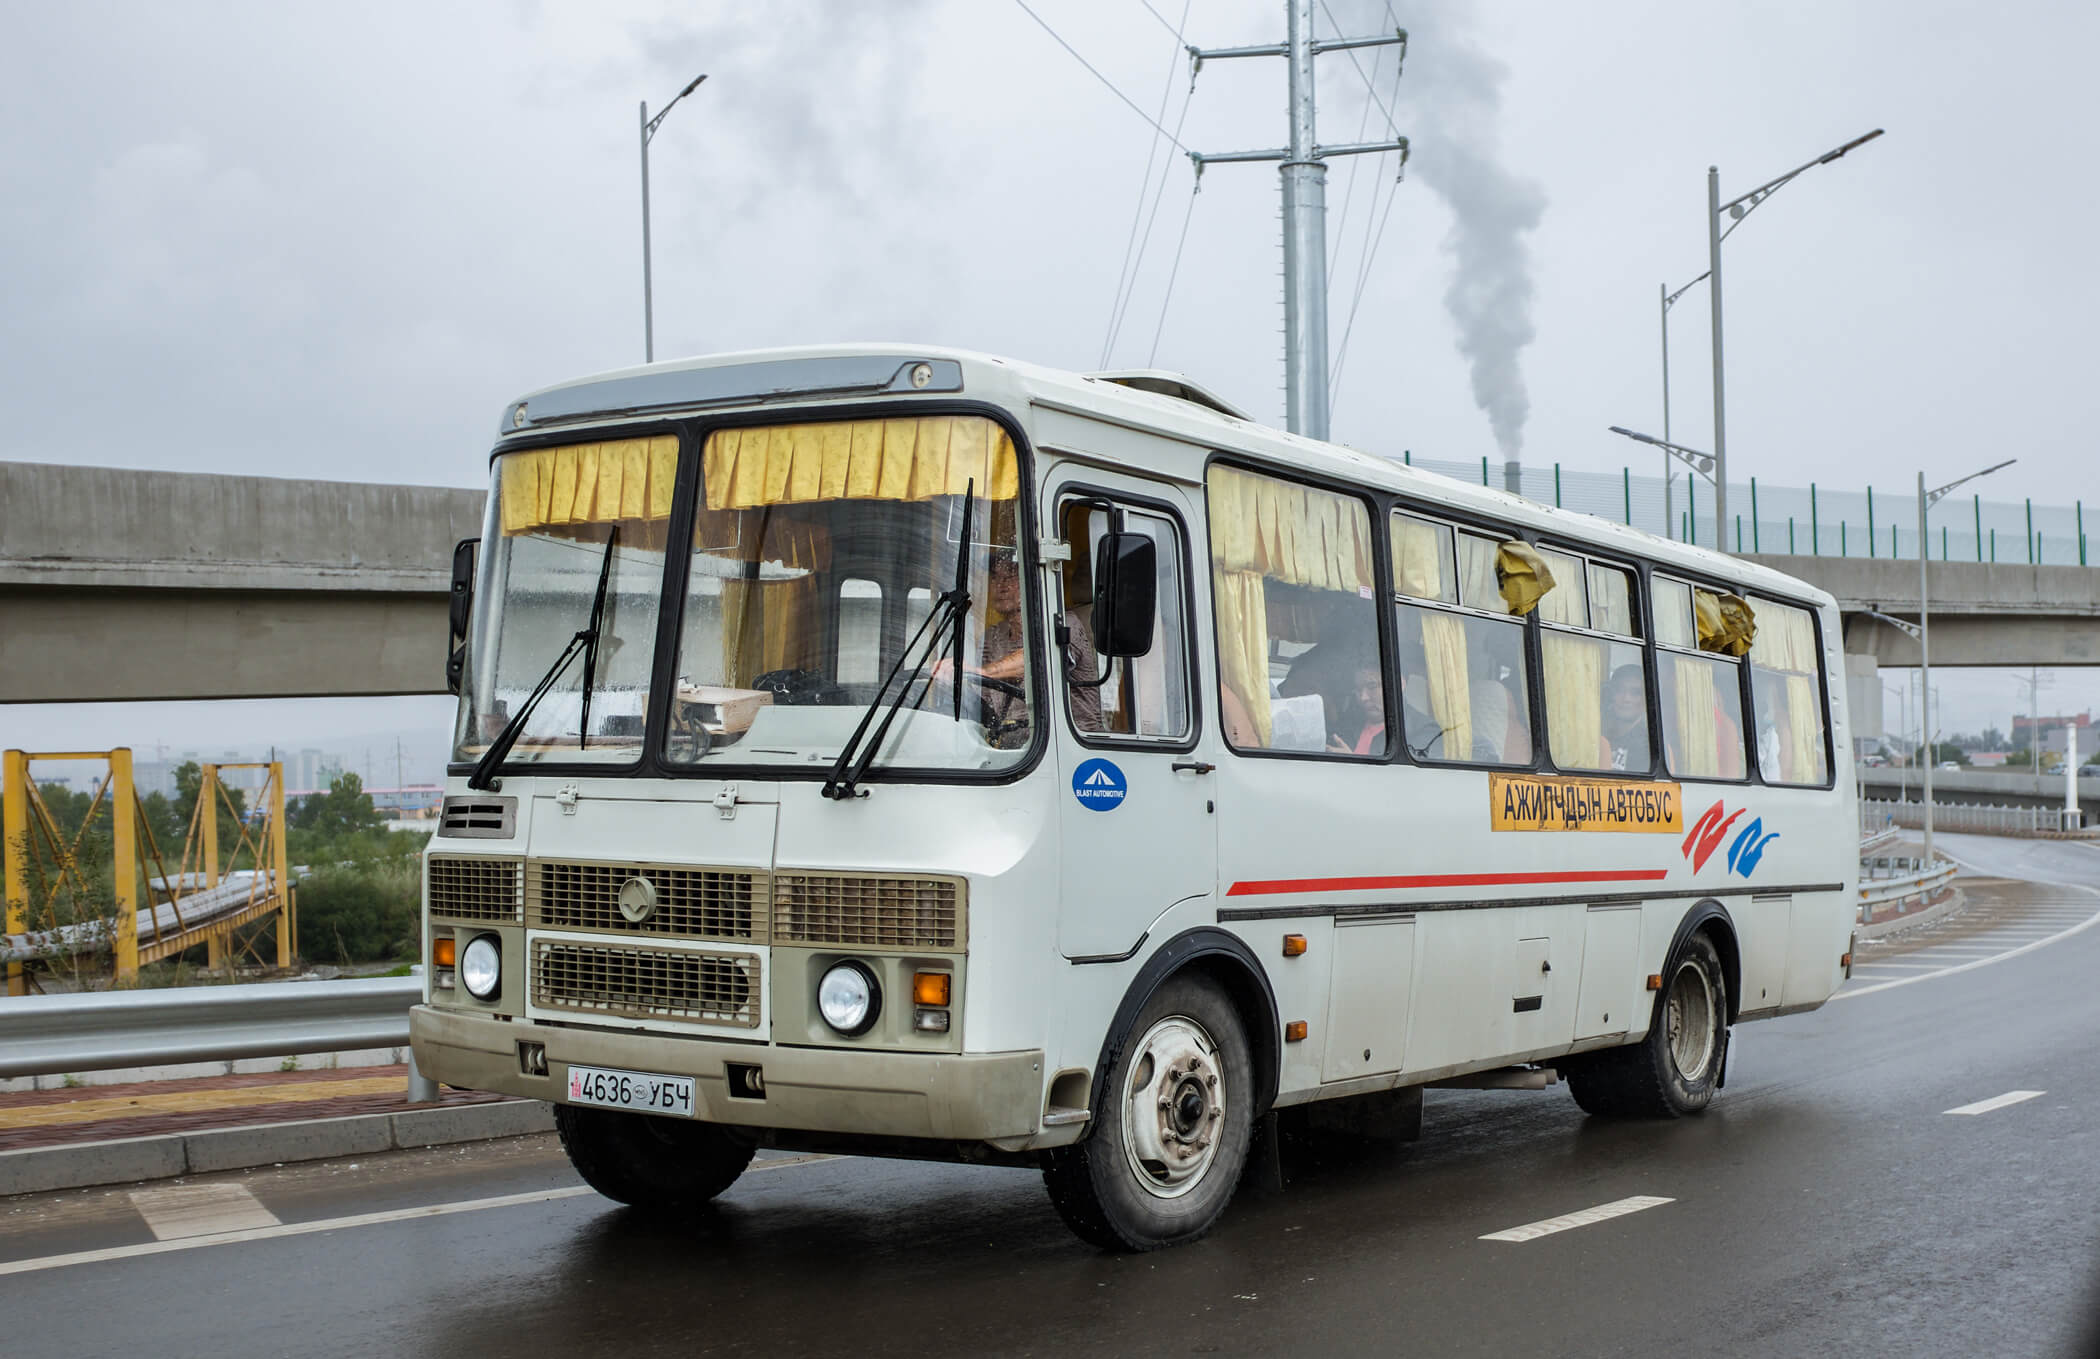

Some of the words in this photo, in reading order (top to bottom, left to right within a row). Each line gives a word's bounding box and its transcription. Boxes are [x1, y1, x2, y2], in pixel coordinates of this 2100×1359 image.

[1503, 784, 1602, 828] АЖИЛЧДЫН
[1606, 789, 1673, 823] АВТОБУС
[582, 1072, 632, 1104] 4636
[649, 1080, 690, 1110] УБЧ
